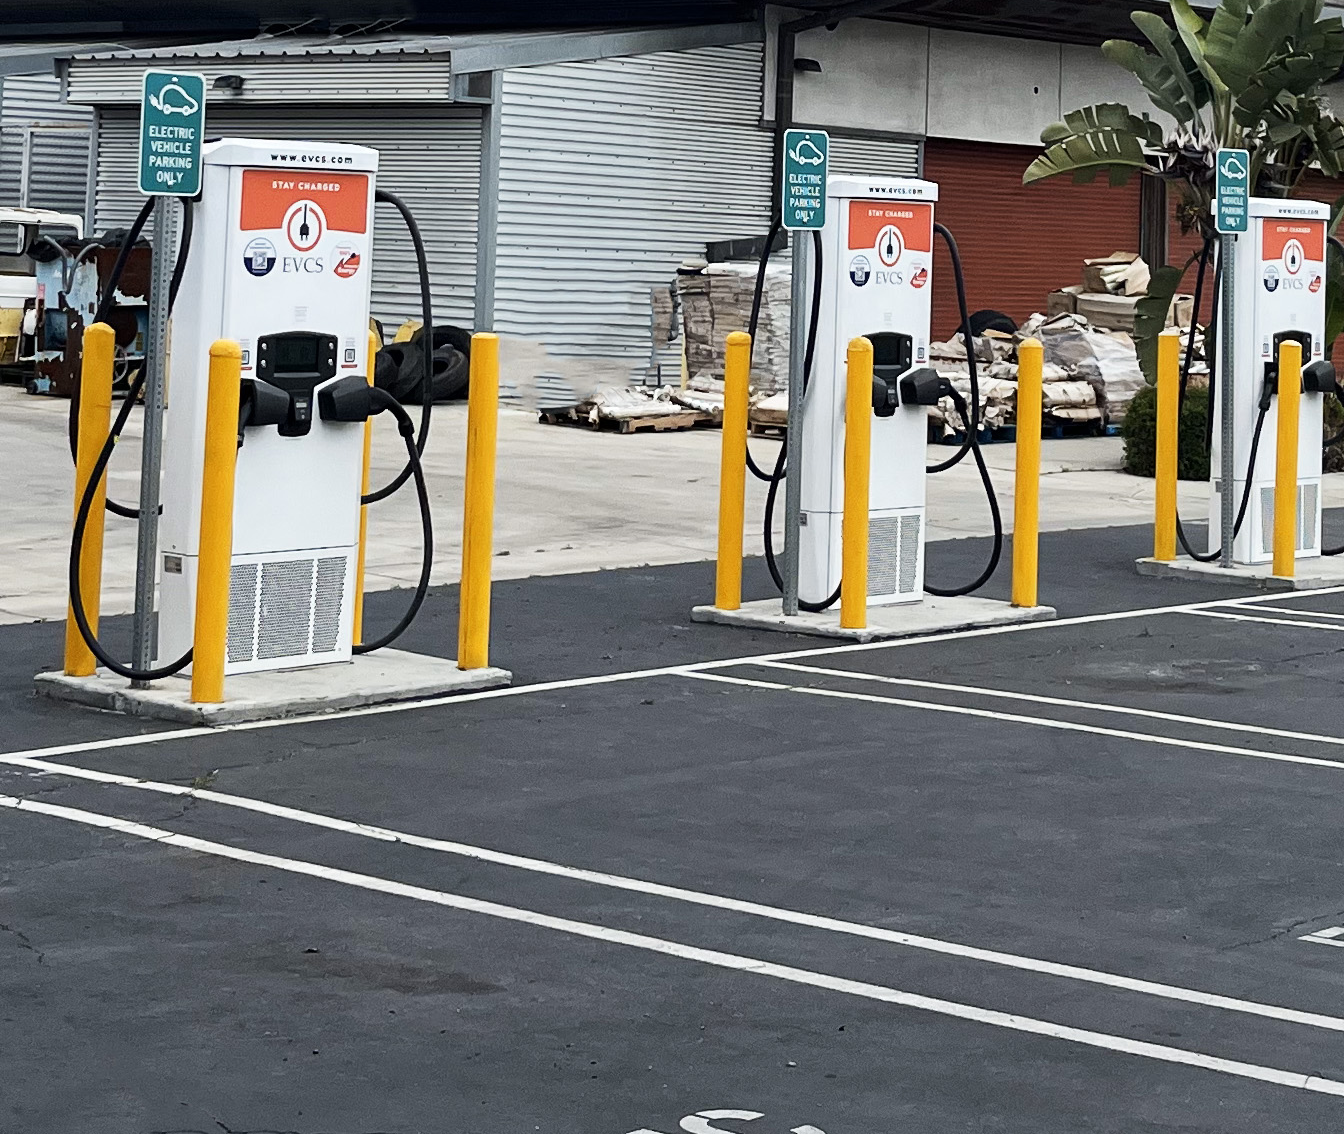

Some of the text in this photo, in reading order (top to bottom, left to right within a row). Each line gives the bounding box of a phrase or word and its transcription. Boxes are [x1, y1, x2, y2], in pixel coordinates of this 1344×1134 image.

[149, 125, 195, 139] ELECTRIC
[151, 140, 192, 154] VEHICLE
[149, 155, 192, 168] PARKING
[271, 154, 353, 164] www.evcs.com
[156, 170, 184, 183] ONLY
[789, 173, 822, 184] ELECTRIC
[272, 181, 341, 191] STAY CHARGED
[790, 186, 821, 196] VEHICLE
[789, 198, 821, 208] PARKING
[795, 210, 815, 220] ONLY
[282, 257, 324, 273] EVCS
[875, 271, 903, 285] EVCS
[1282, 278, 1304, 290] EVCS
